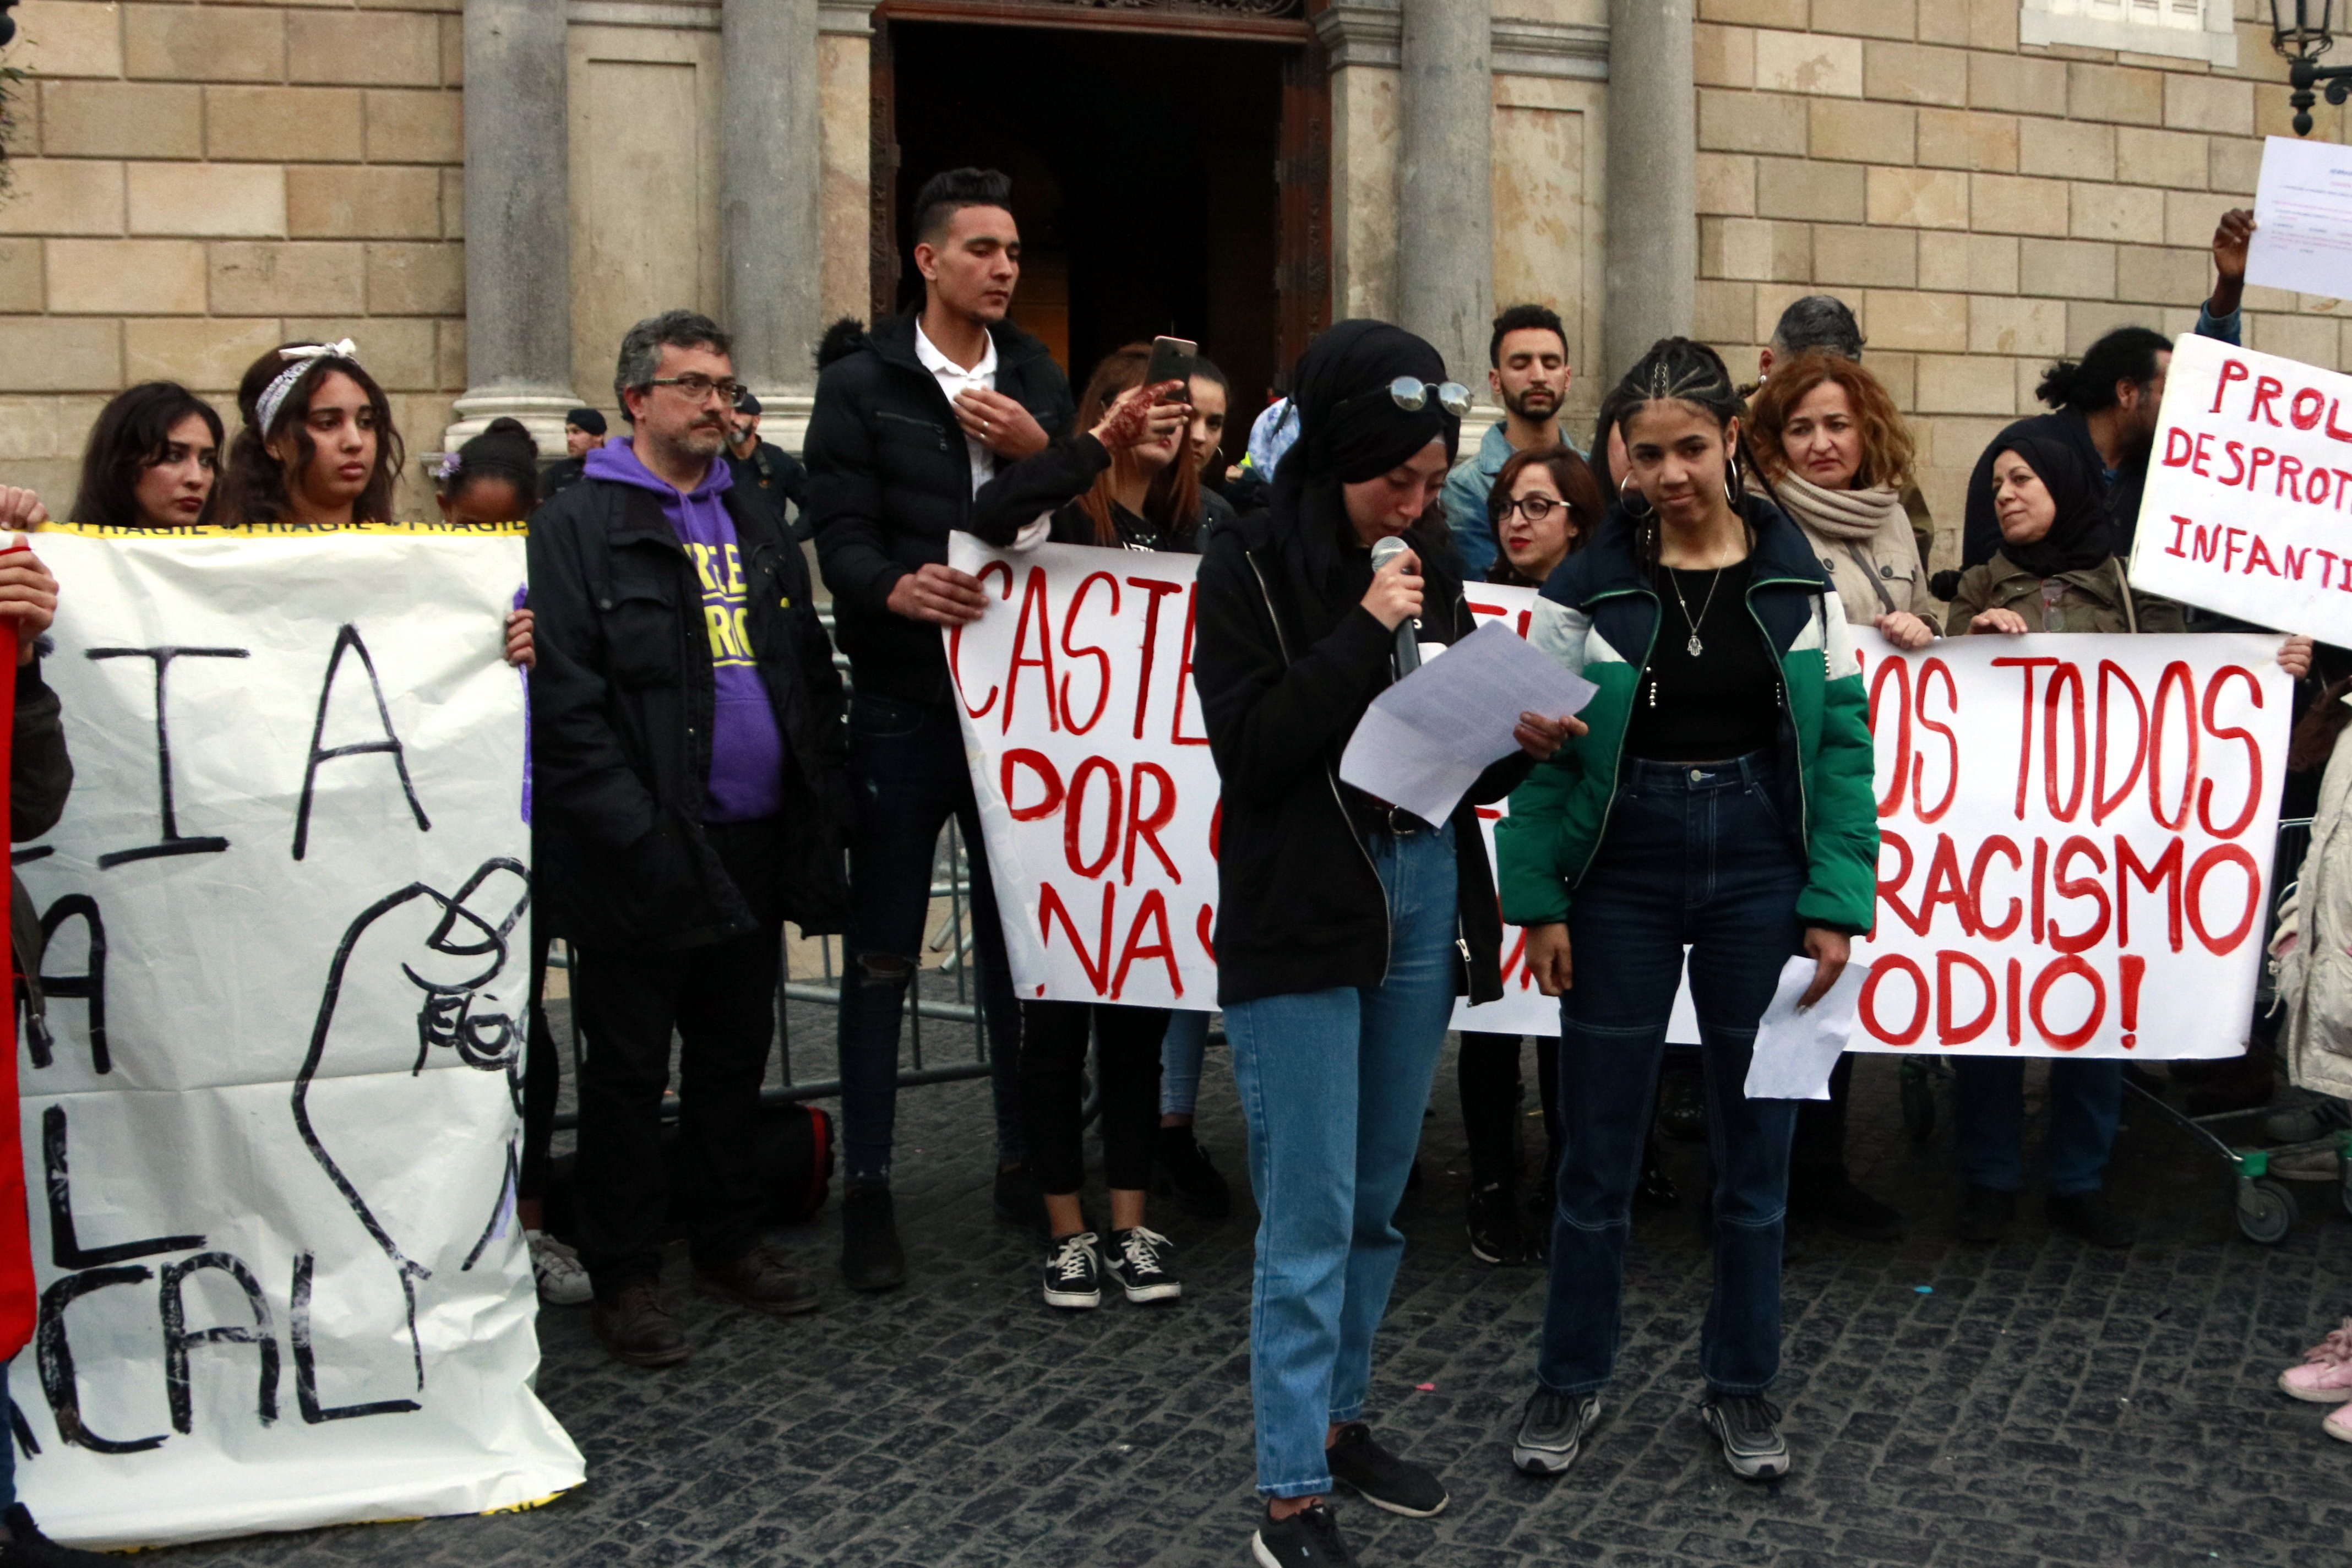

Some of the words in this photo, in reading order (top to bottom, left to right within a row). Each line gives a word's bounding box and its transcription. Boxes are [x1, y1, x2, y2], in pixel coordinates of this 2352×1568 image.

[2208, 359, 2352, 443] PROL
[2162, 427, 2352, 515] DESPROT
[1855, 648, 1958, 824] OS
[1991, 656, 2264, 840] TODOS
[1001, 748, 1182, 886] POR
[1866, 833, 2261, 956] RACISMO
[1858, 951, 2146, 1051] ODIO!
